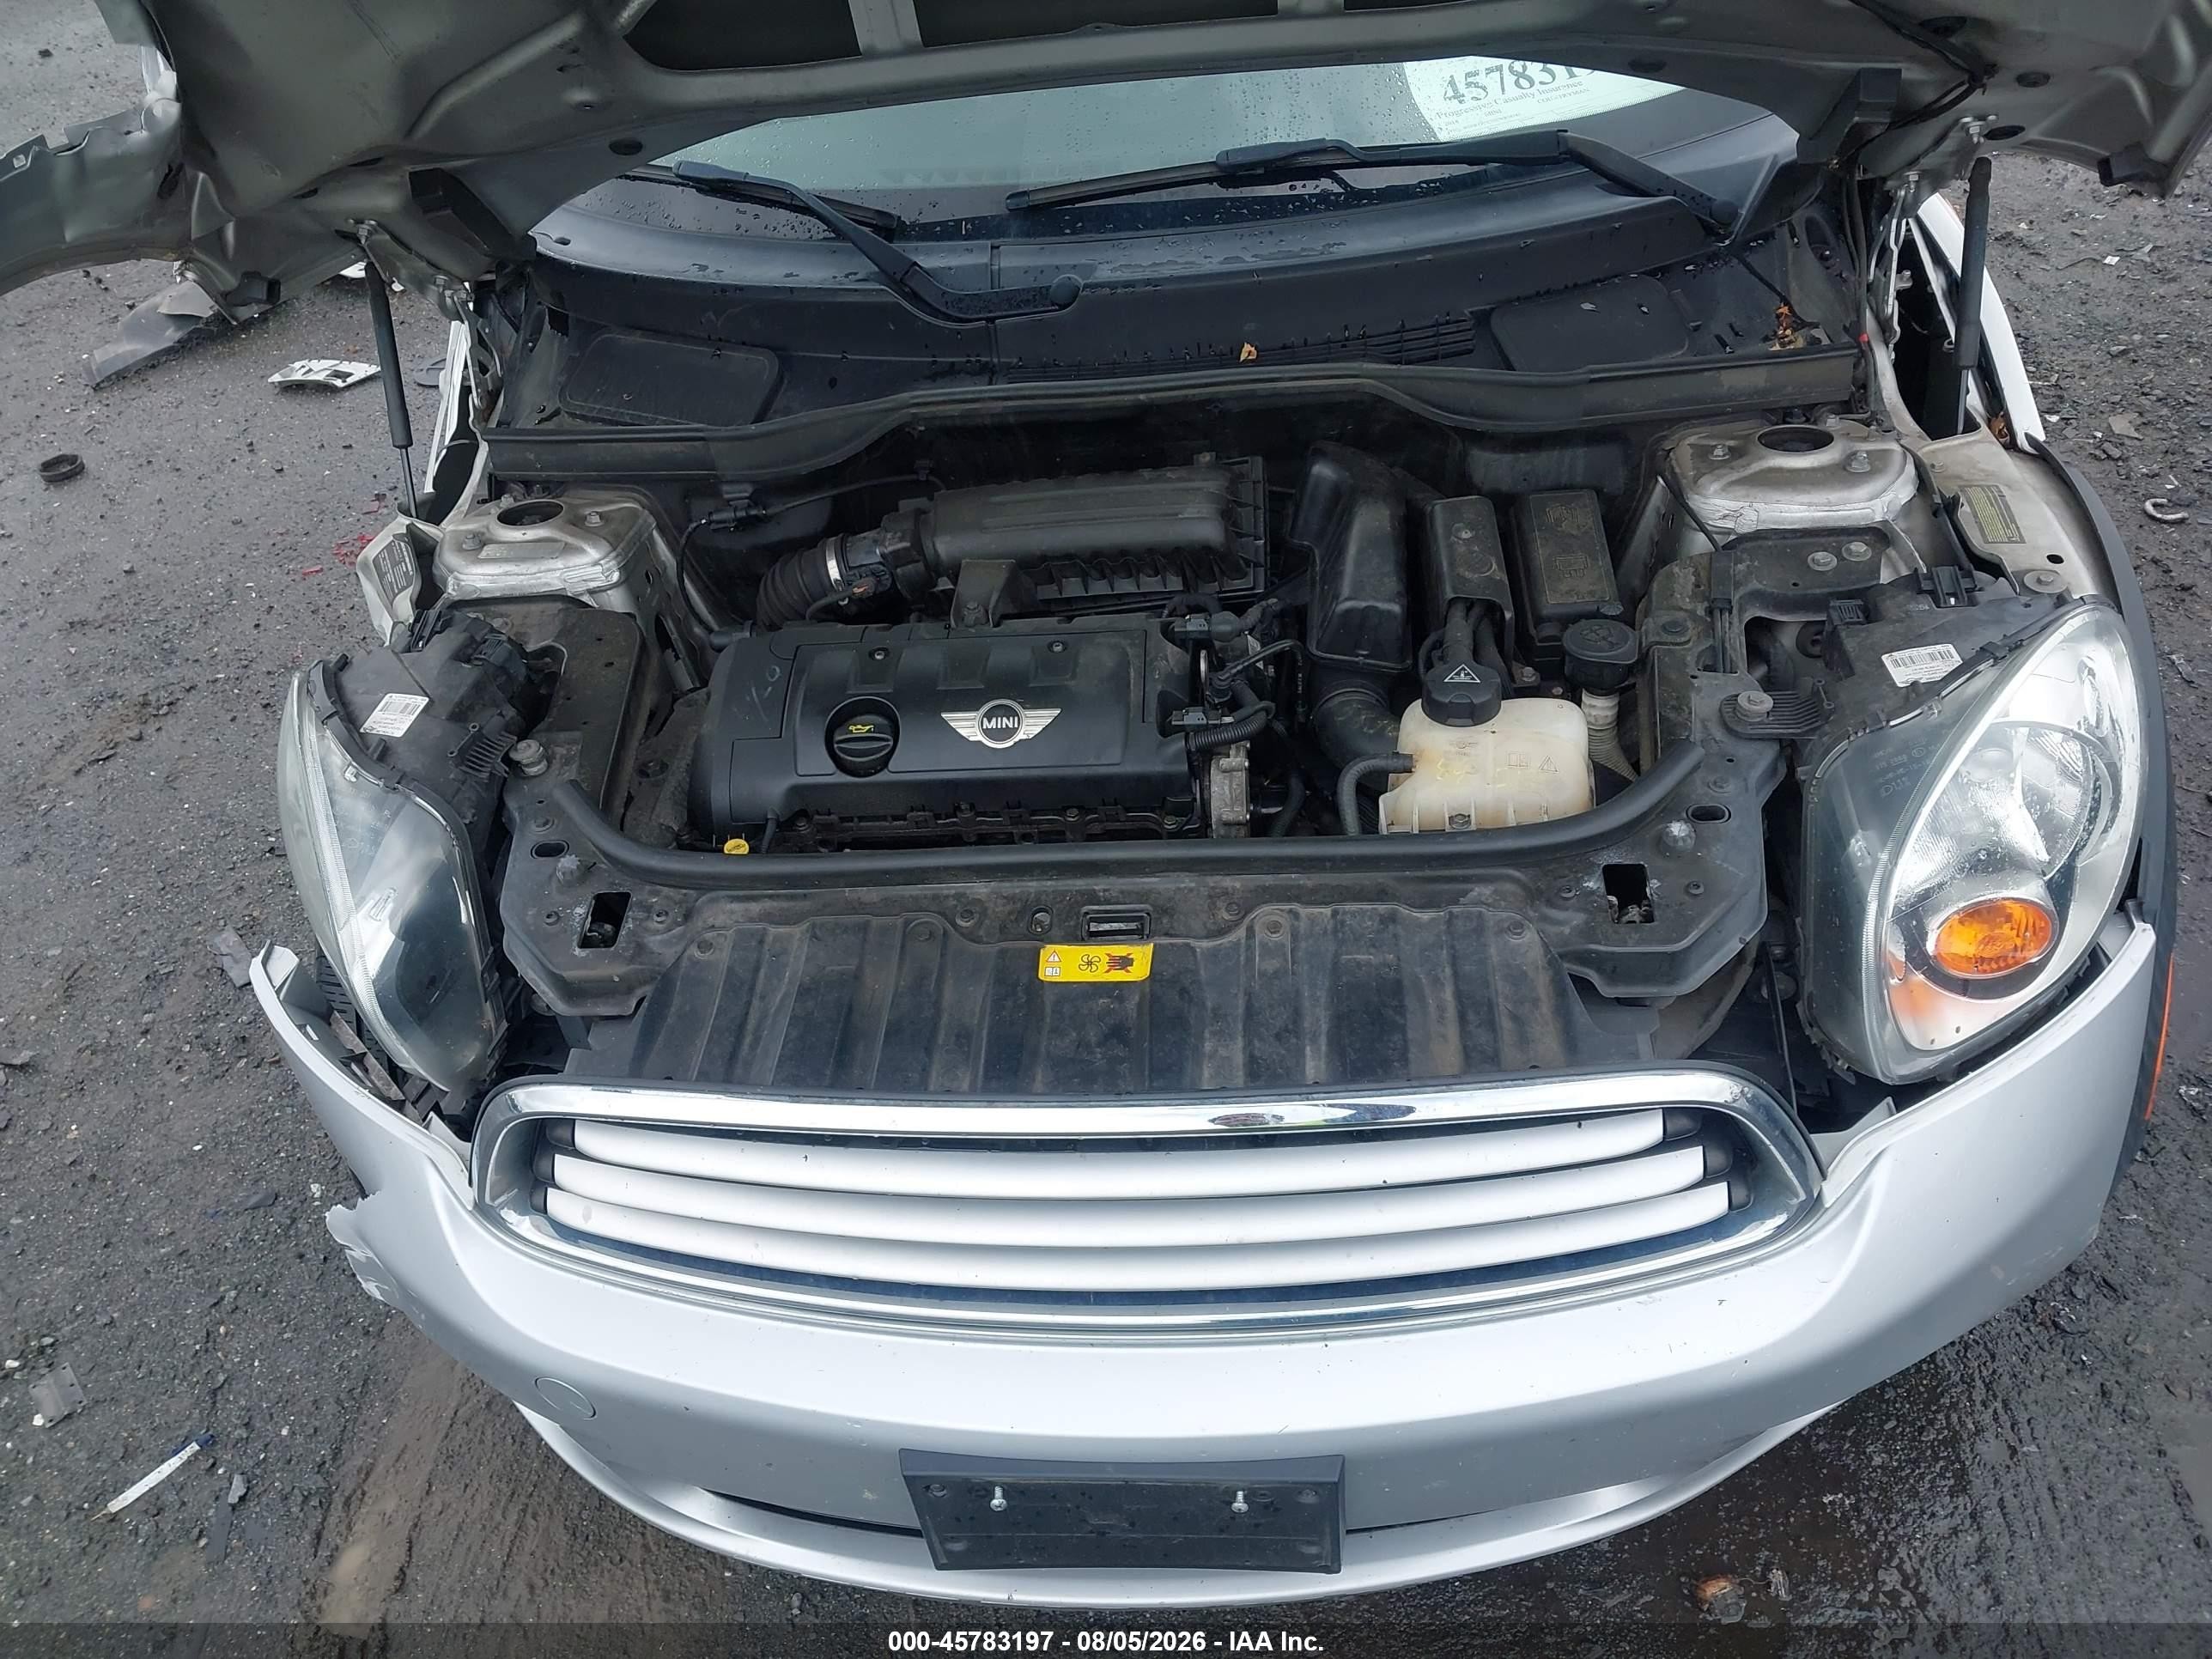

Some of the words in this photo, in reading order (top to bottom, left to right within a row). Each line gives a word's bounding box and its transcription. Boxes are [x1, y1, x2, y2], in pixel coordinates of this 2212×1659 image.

[1436, 101, 1494, 118] Progressive
[1494, 90, 1535, 106] Casualty
[1537, 80, 1583, 95] Insurance
[1443, 60, 1595, 104] 45783
[982, 716, 1018, 729] MINI
